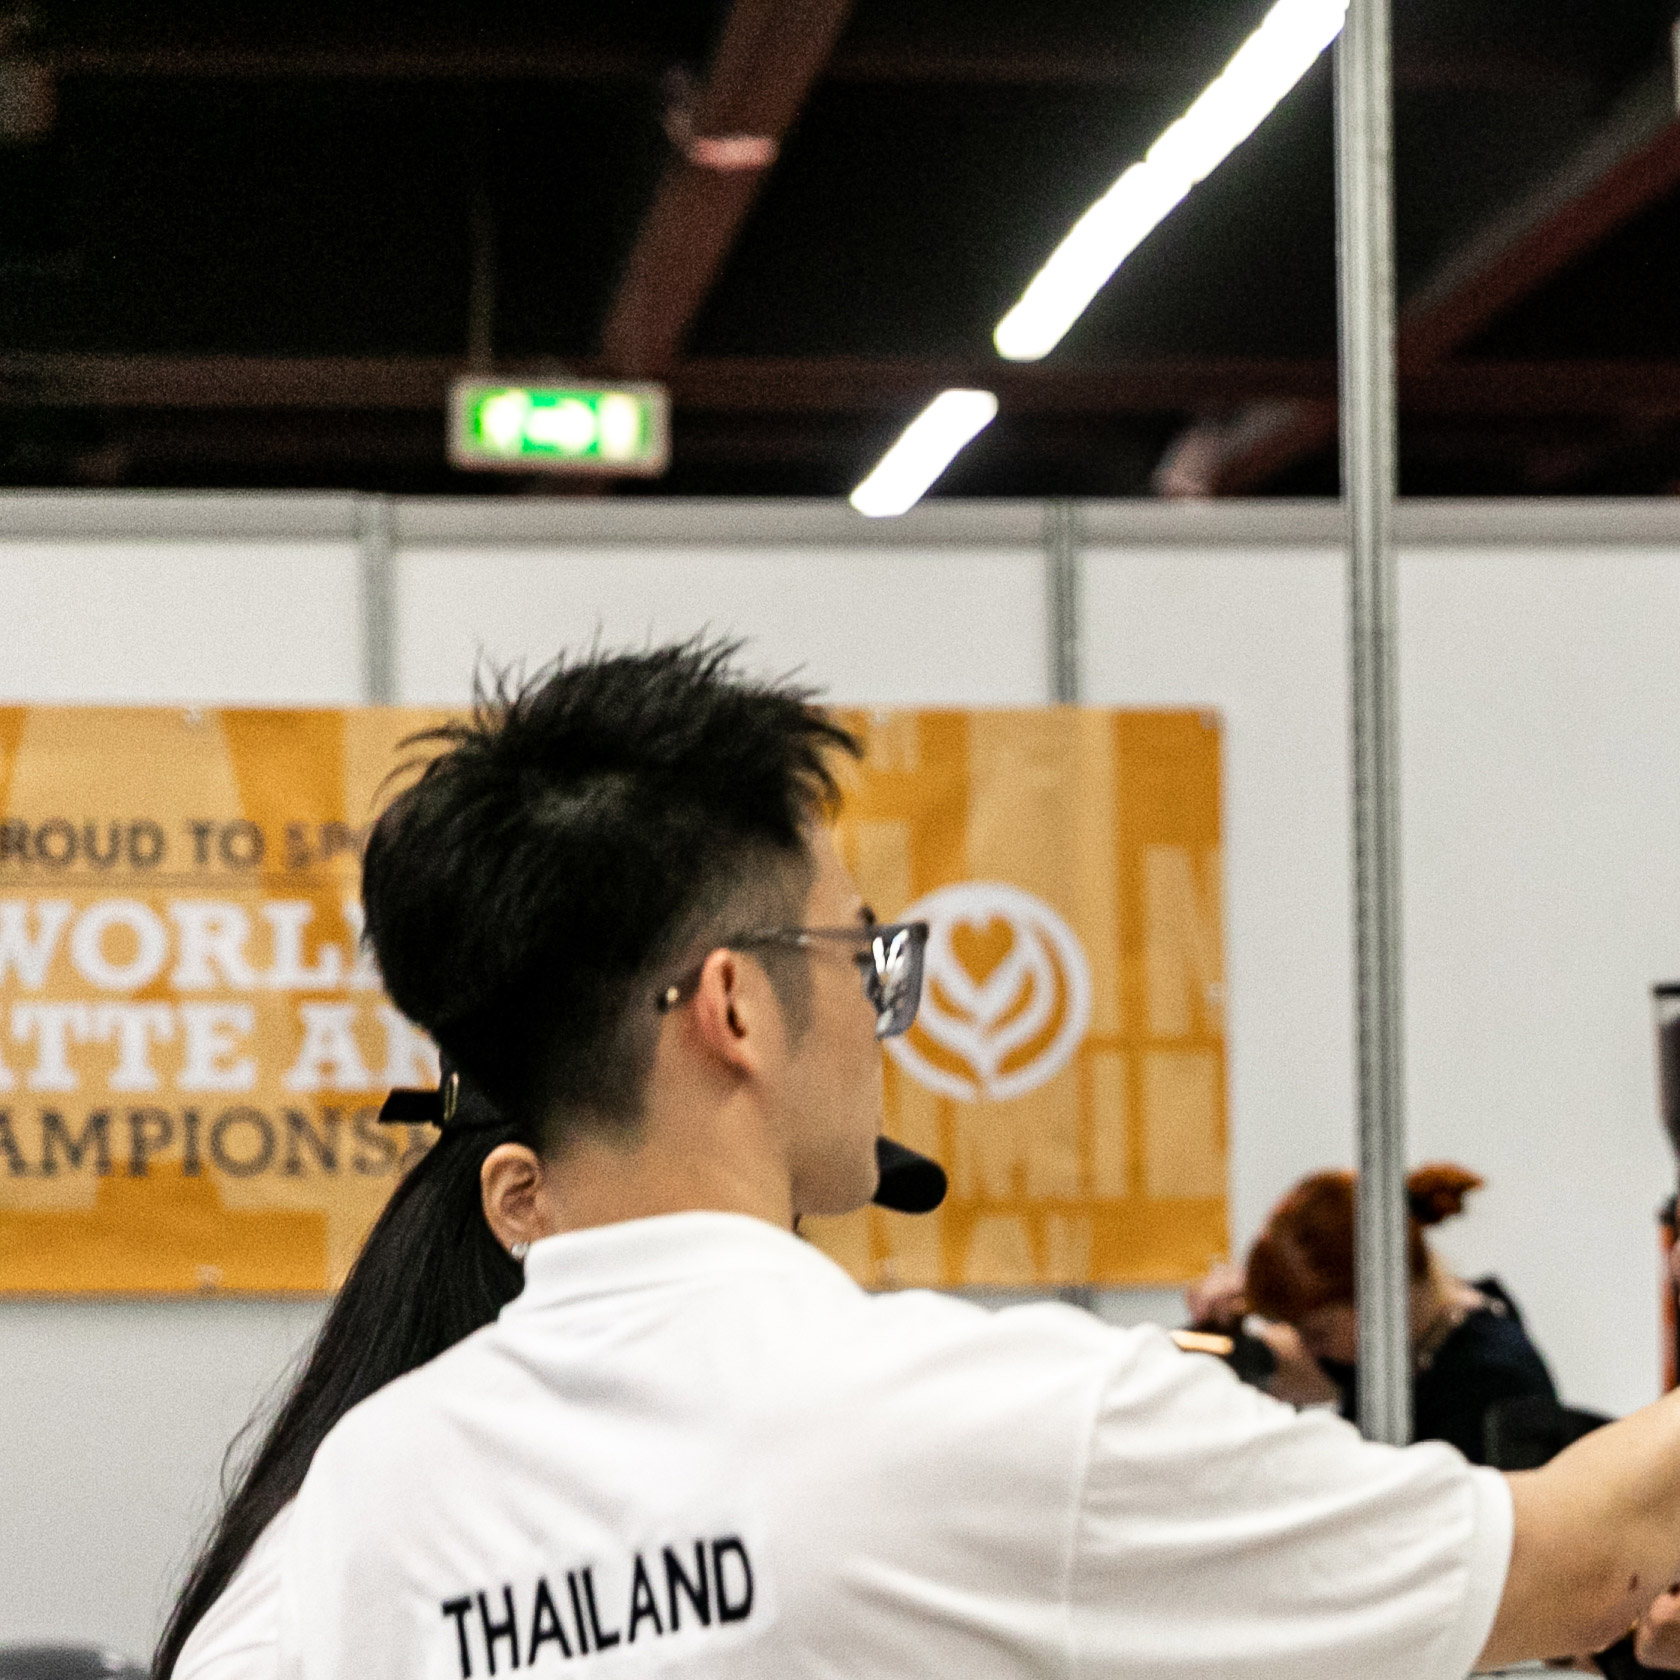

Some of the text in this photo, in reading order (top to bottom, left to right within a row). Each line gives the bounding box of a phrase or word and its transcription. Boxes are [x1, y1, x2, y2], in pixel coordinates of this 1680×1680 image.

[188, 817, 266, 869] TO
[0, 1001, 256, 1093] TTE
[441, 1534, 754, 1680] THAILAND
